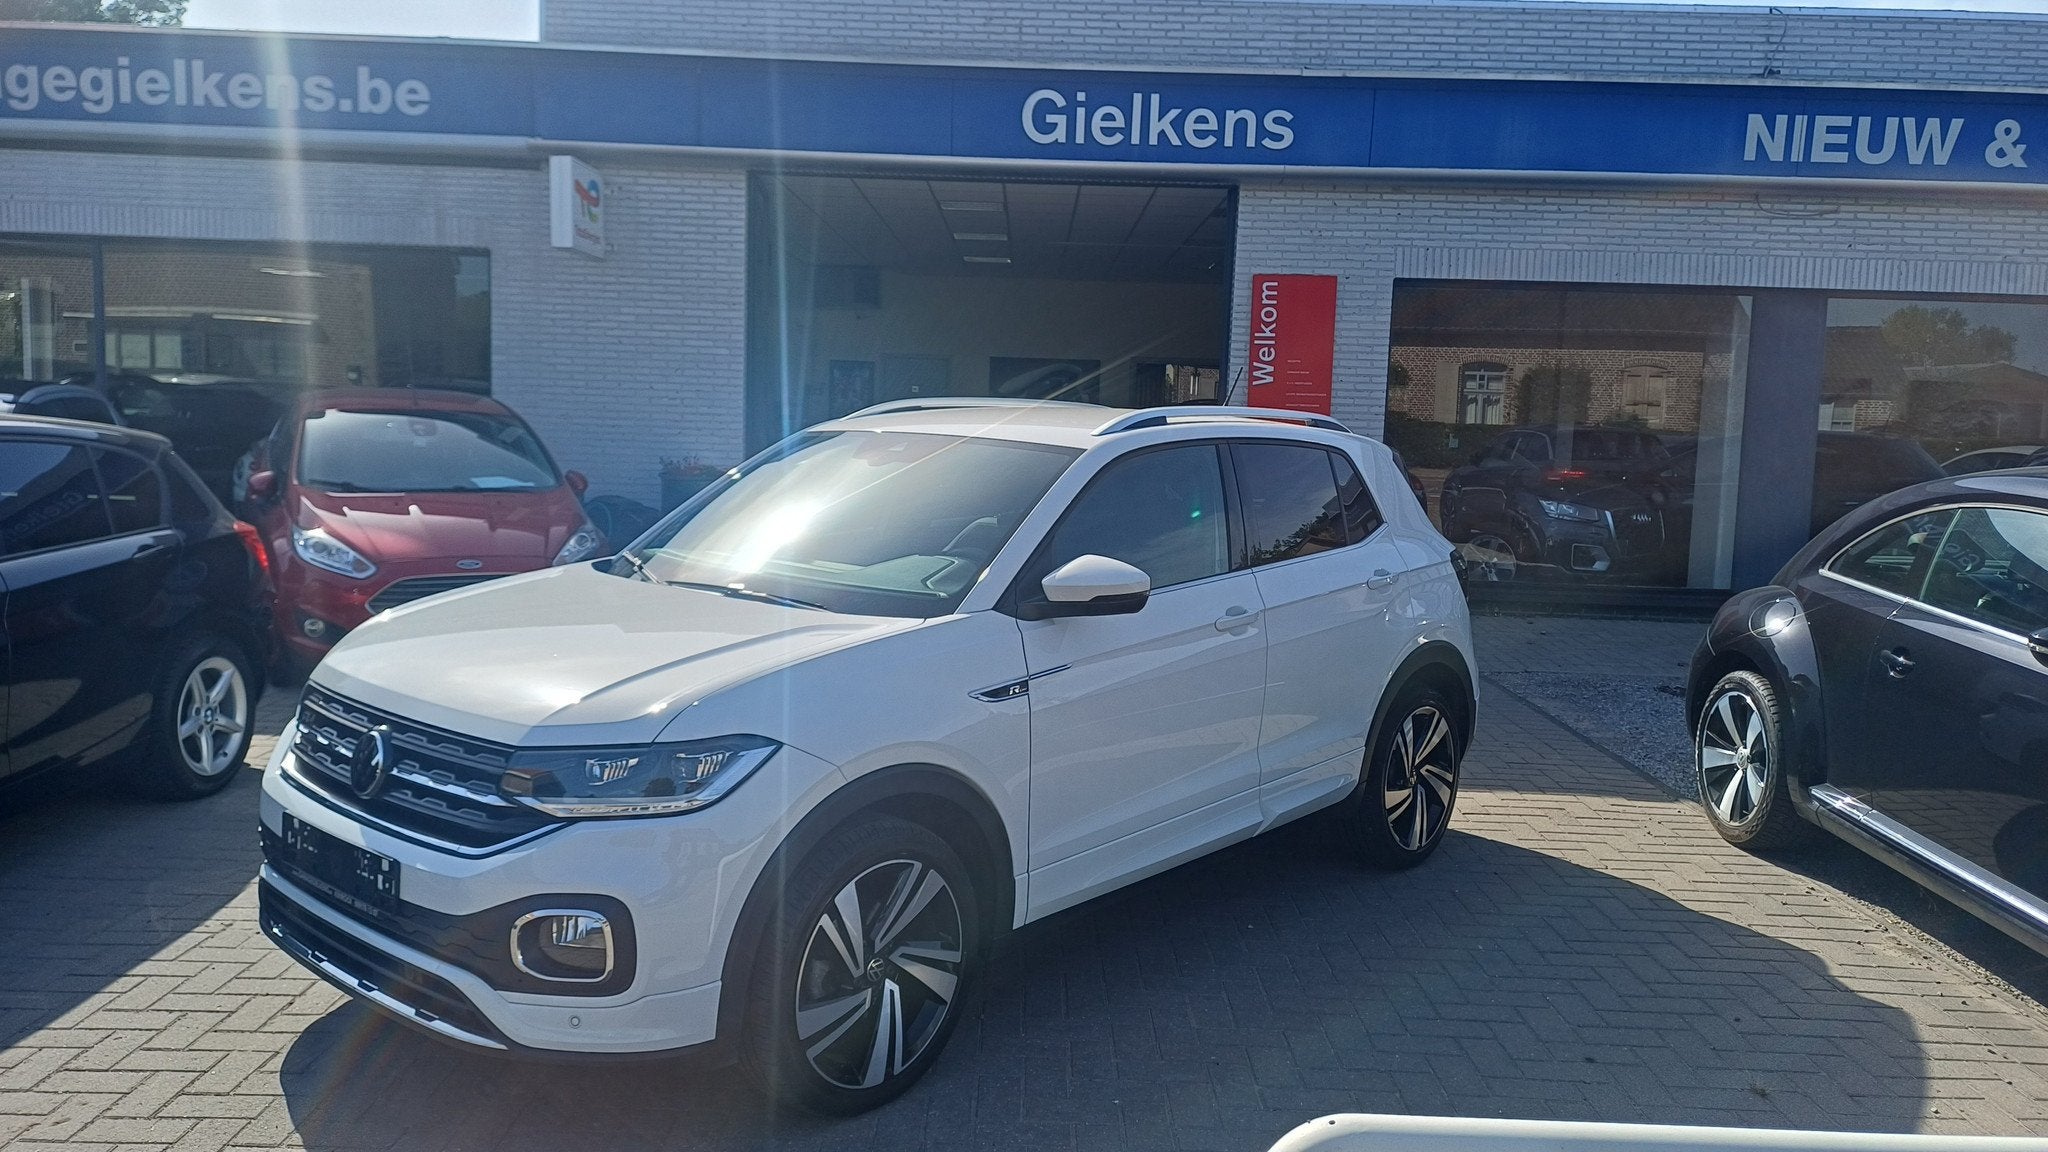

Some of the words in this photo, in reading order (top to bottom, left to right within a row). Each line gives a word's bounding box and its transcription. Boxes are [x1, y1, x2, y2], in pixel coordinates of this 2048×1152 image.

[0, 56, 431, 116] gegielkens.be
[1021, 88, 1295, 150] Gielkens
[1743, 113, 1965, 166] NIEUW
[1984, 118, 2028, 168] &
[1252, 281, 1279, 386] Welkom
